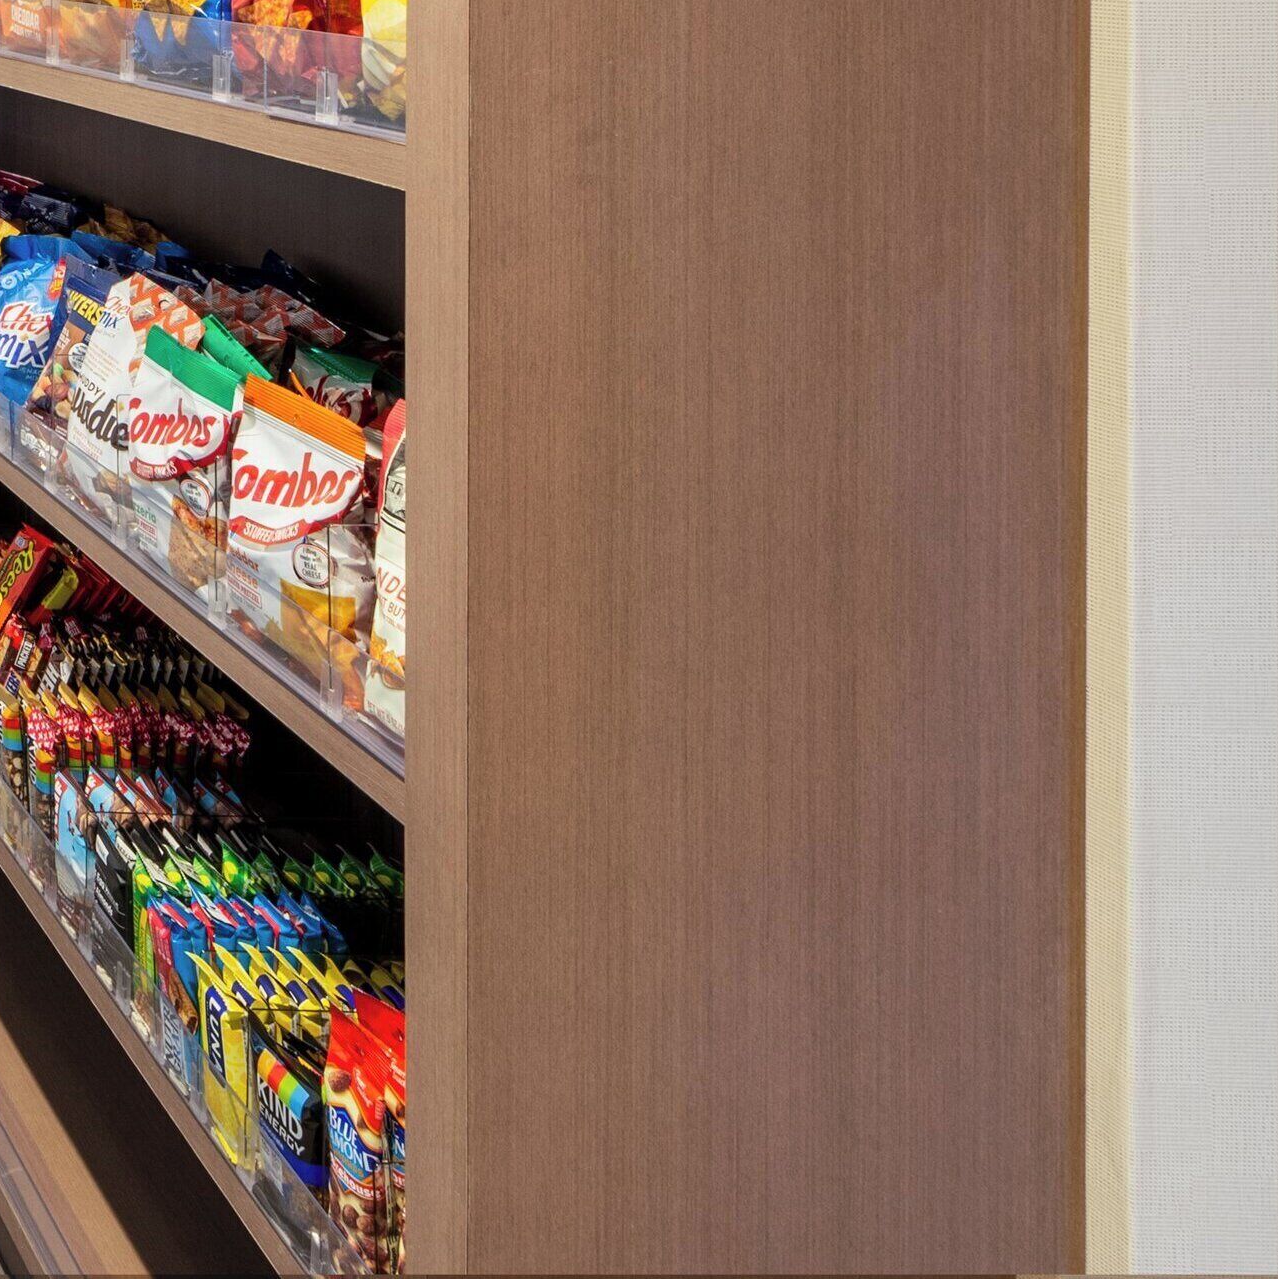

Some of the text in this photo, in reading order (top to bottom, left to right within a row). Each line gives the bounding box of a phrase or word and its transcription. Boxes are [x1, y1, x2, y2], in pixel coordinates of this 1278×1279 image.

[69, 288, 103, 328] NTERS
[72, 387, 130, 452] uddie
[243, 521, 300, 542] STUFFED SNACKS
[301, 568, 323, 580] CHEESE
[303, 561, 317, 571] REAL
[208, 995, 225, 1076] LUNA
[257, 1073, 305, 1141] KIND
[329, 1105, 359, 1145] BLUE
[258, 1102, 306, 1158] ENERGY
[331, 1128, 380, 1174] AMOND
